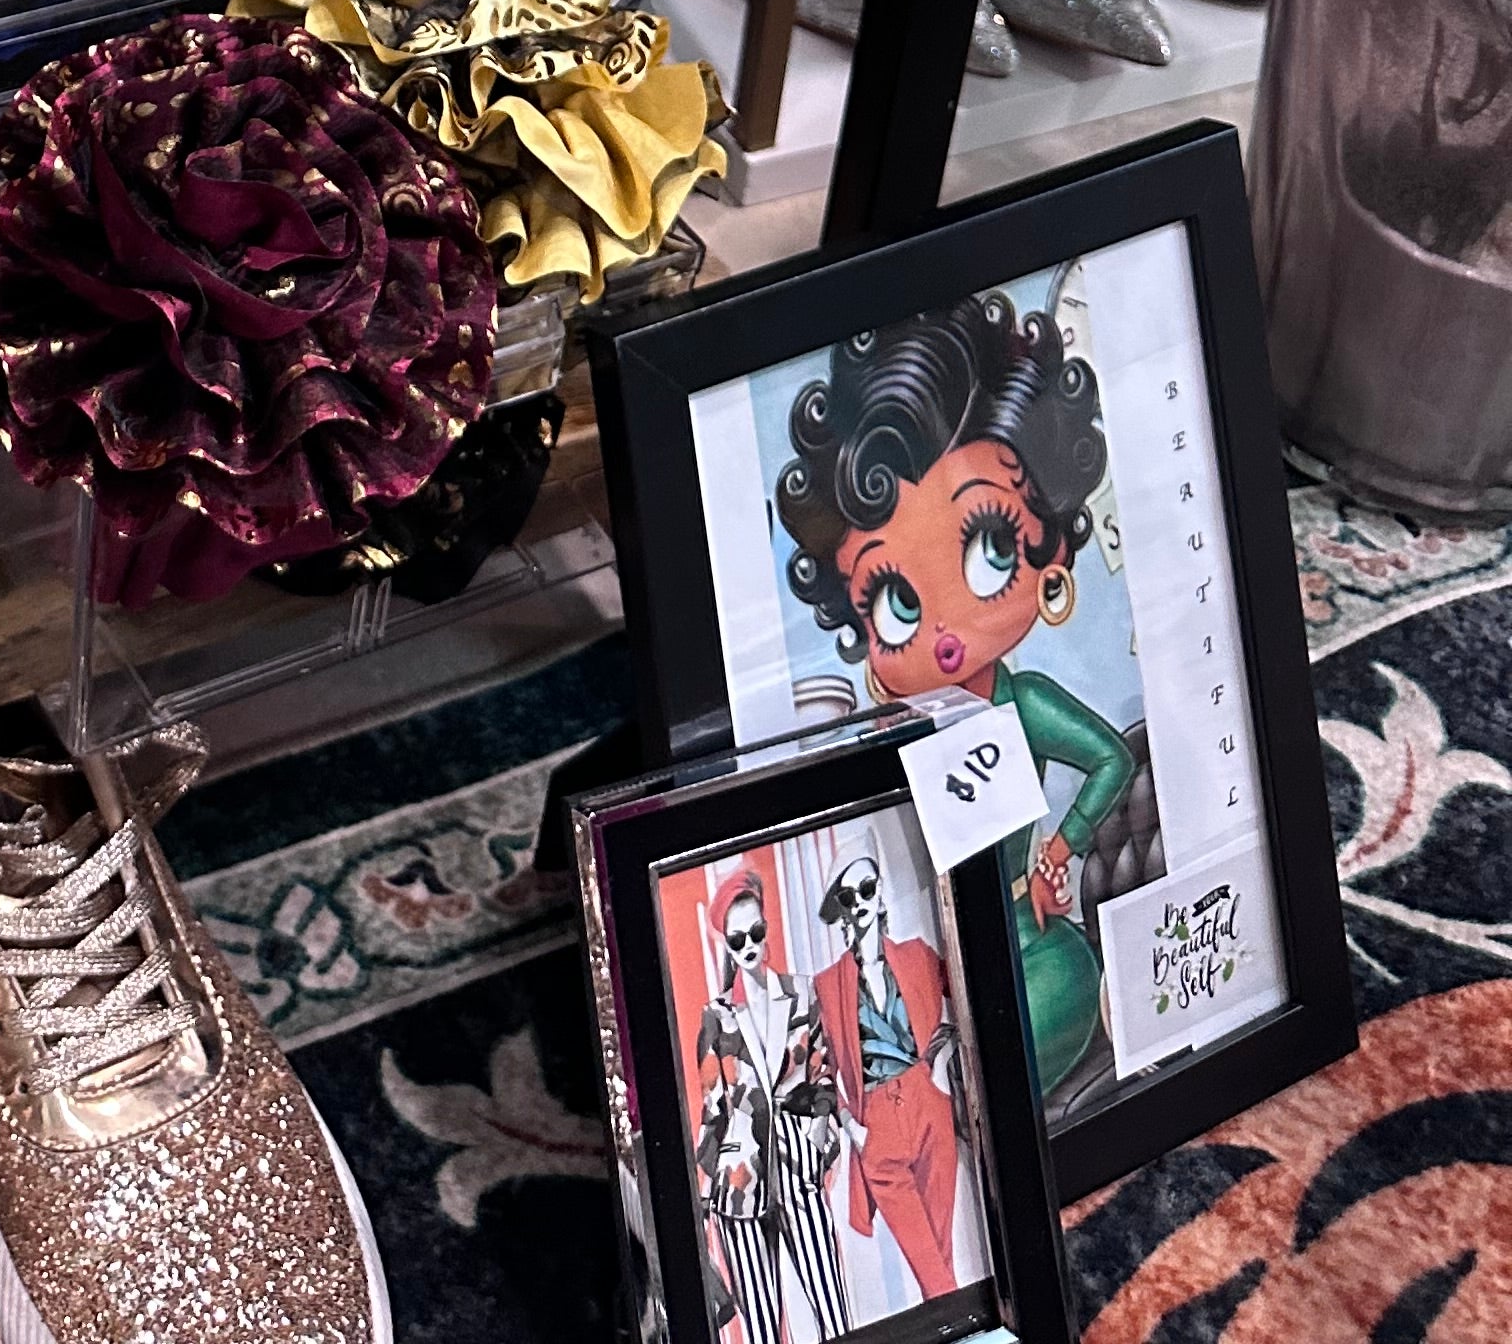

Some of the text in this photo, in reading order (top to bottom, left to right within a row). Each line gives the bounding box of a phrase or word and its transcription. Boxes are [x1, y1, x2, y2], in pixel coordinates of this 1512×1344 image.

[945, 742, 1001, 803] $10
[1152, 893, 1241, 987] Beautiful
[1163, 902, 1188, 940] Be
[1177, 953, 1223, 1010] Self
